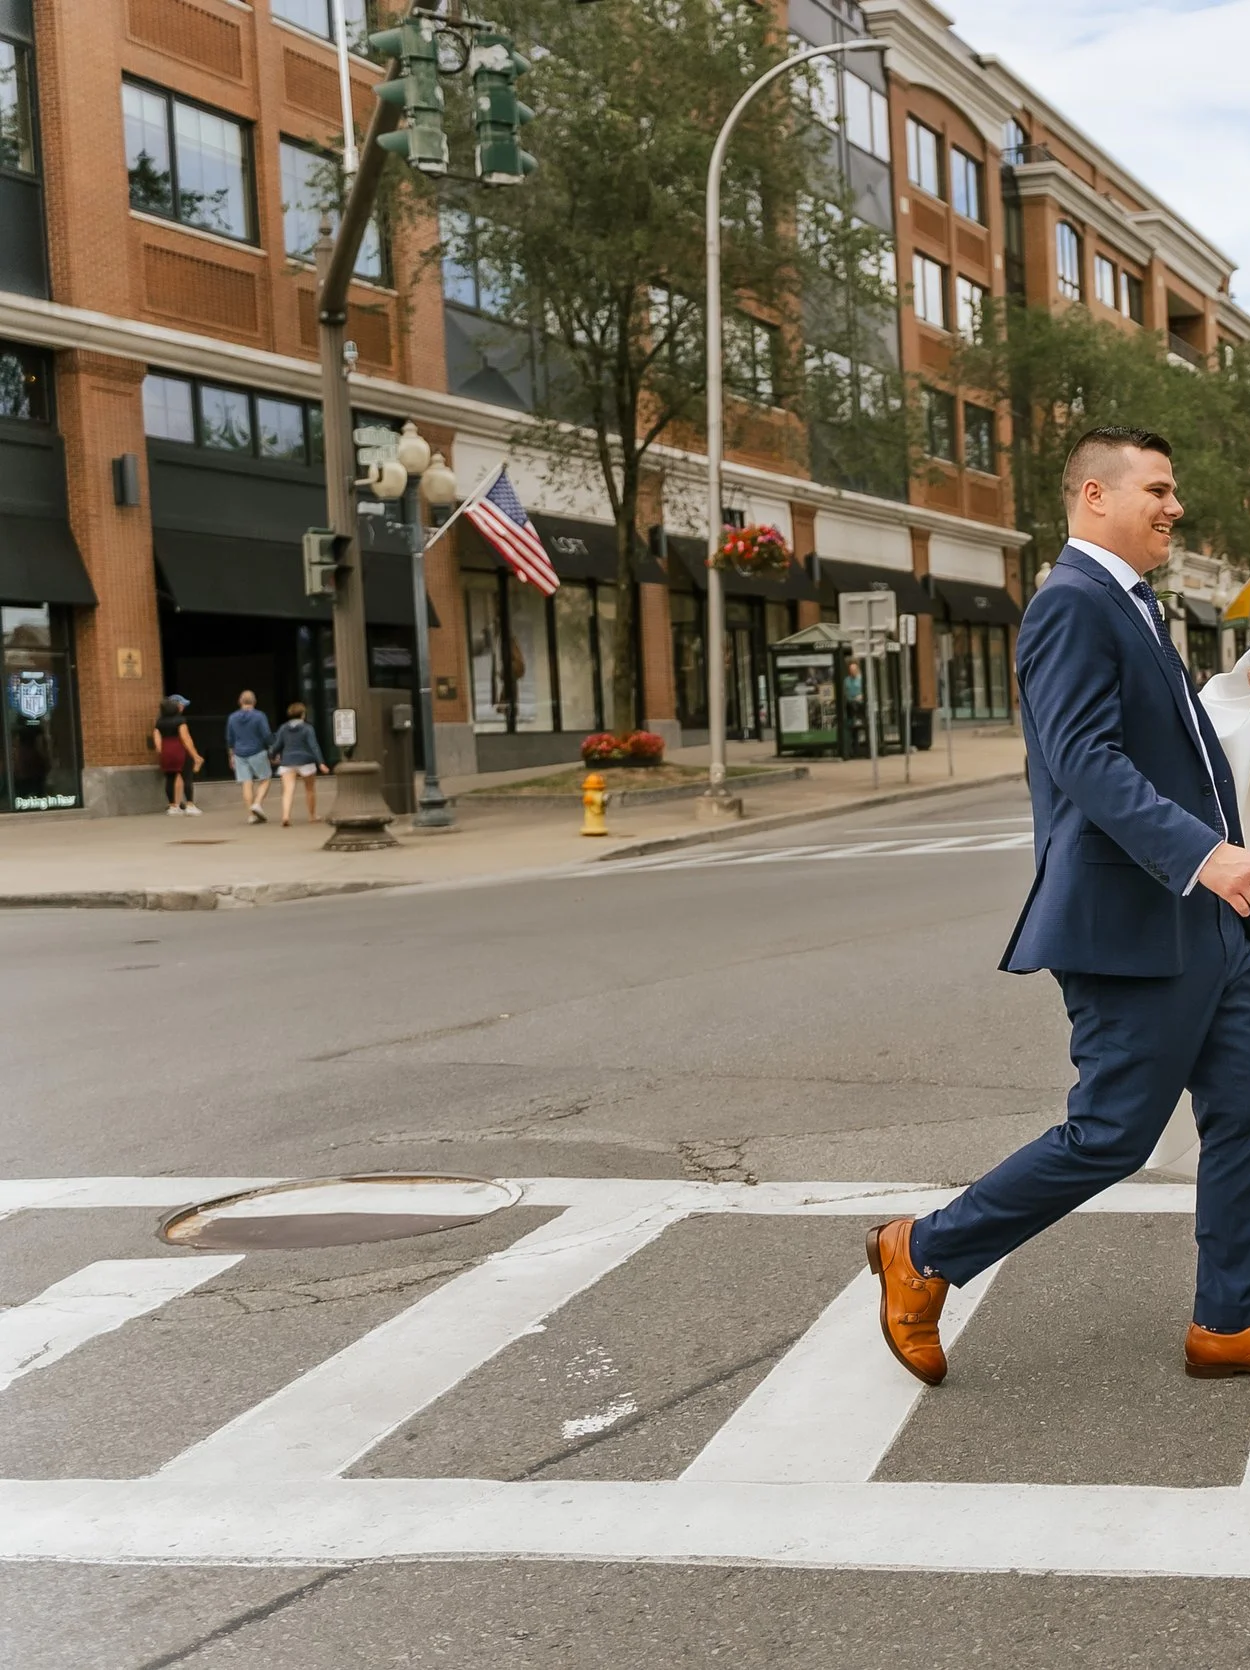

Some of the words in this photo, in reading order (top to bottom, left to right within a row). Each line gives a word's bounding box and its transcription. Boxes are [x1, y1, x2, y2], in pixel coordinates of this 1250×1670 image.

[550, 536, 589, 555] LOFT
[24, 697, 45, 713] NFL
[15, 796, 48, 810] Parking
[57, 794, 76, 807] Rear
